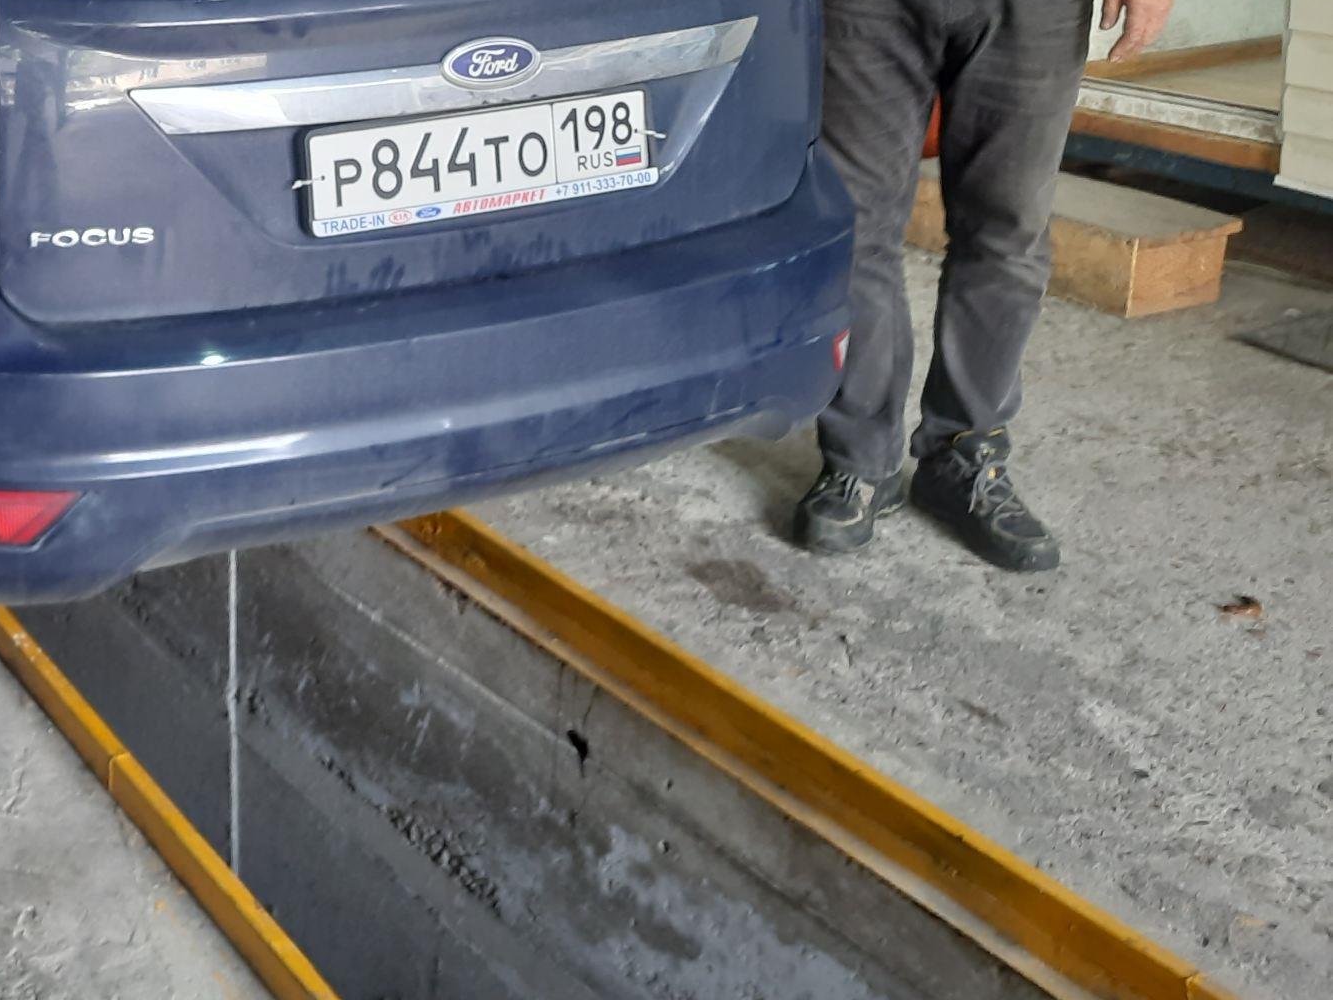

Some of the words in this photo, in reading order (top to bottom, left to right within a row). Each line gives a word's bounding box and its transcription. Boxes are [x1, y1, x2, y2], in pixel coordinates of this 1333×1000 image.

[467, 48, 519, 77] Ford
[560, 101, 633, 154] 198
[577, 150, 614, 172] RUS
[322, 214, 385, 234] TRADE-IN
[29, 227, 155, 248] FOCUS
